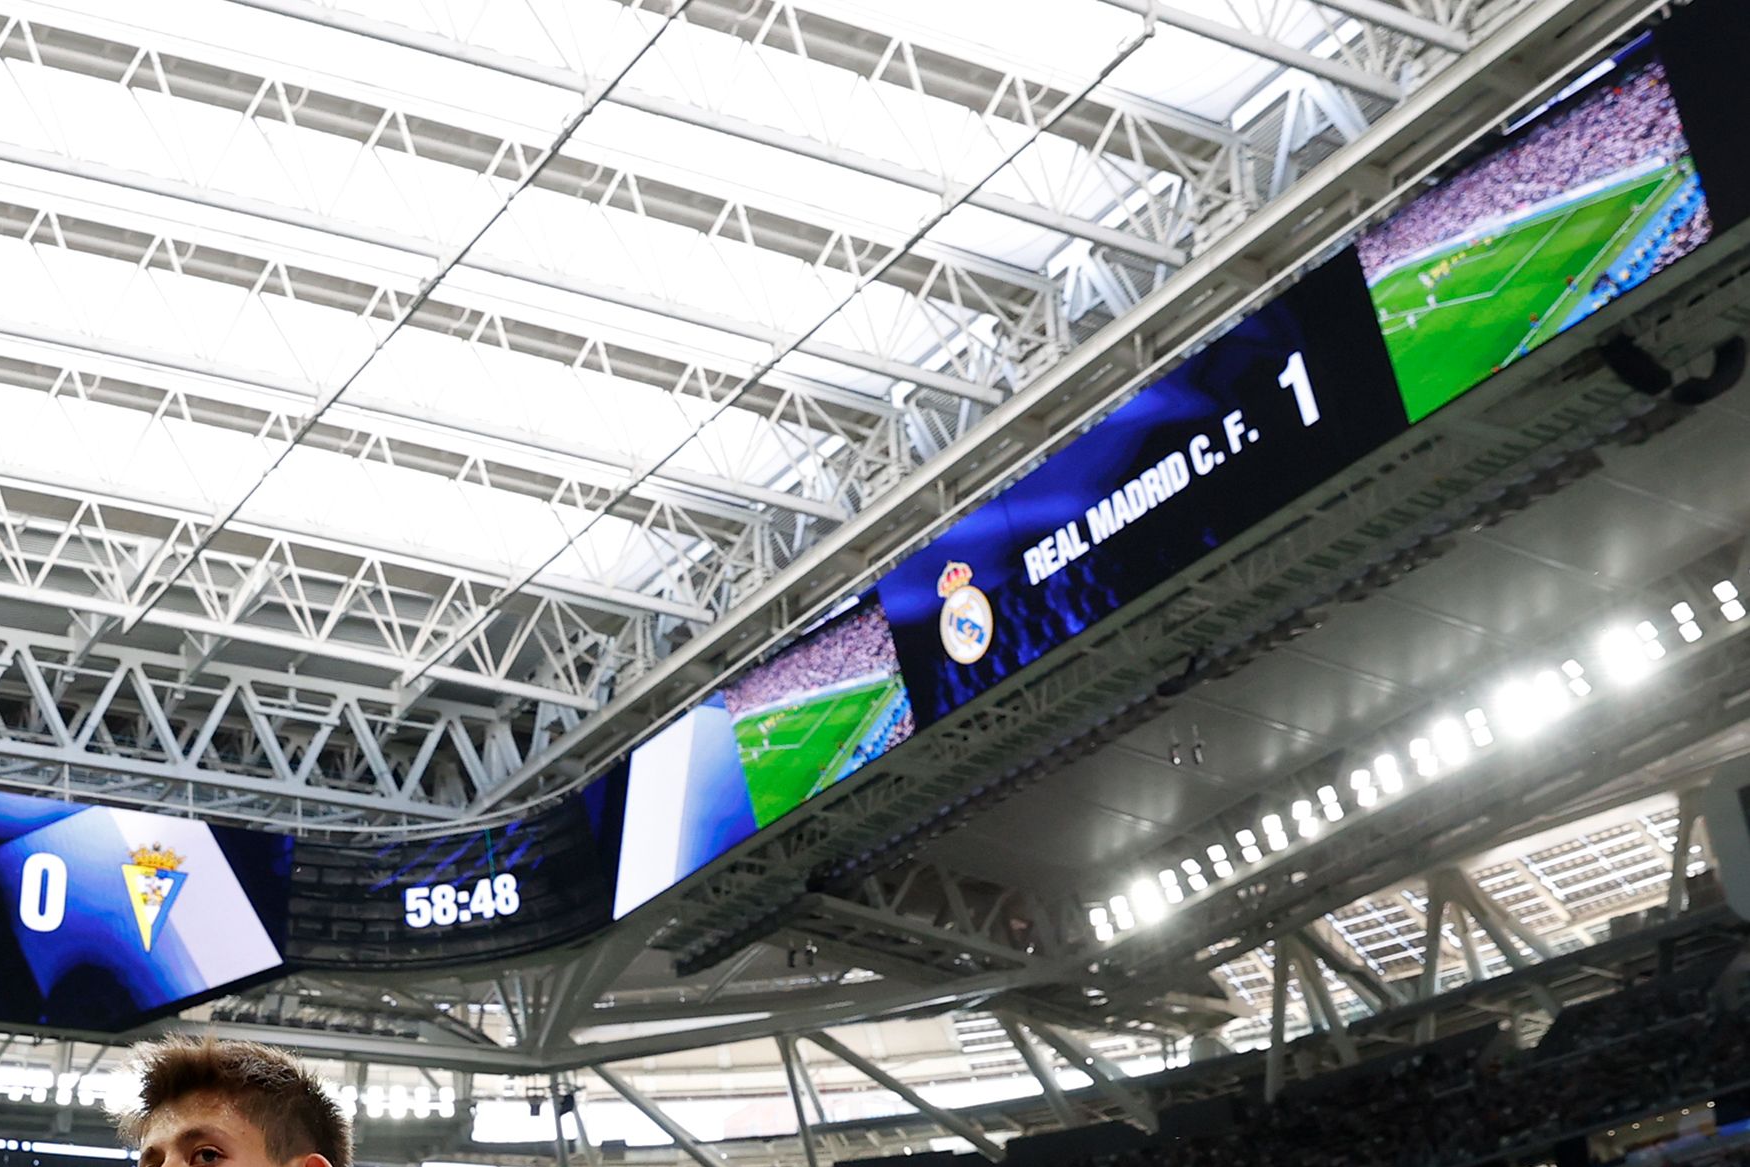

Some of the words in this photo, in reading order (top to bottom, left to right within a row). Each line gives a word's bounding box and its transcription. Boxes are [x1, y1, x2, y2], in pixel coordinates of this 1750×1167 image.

[1023, 520, 1090, 586] REAL
[1086, 451, 1190, 545] MADRID
[1189, 433, 1226, 476] C.
[1223, 409, 1260, 455] F.
[1277, 350, 1321, 427] 1
[19, 852, 68, 932] 0
[405, 873, 520, 928] 58:48
